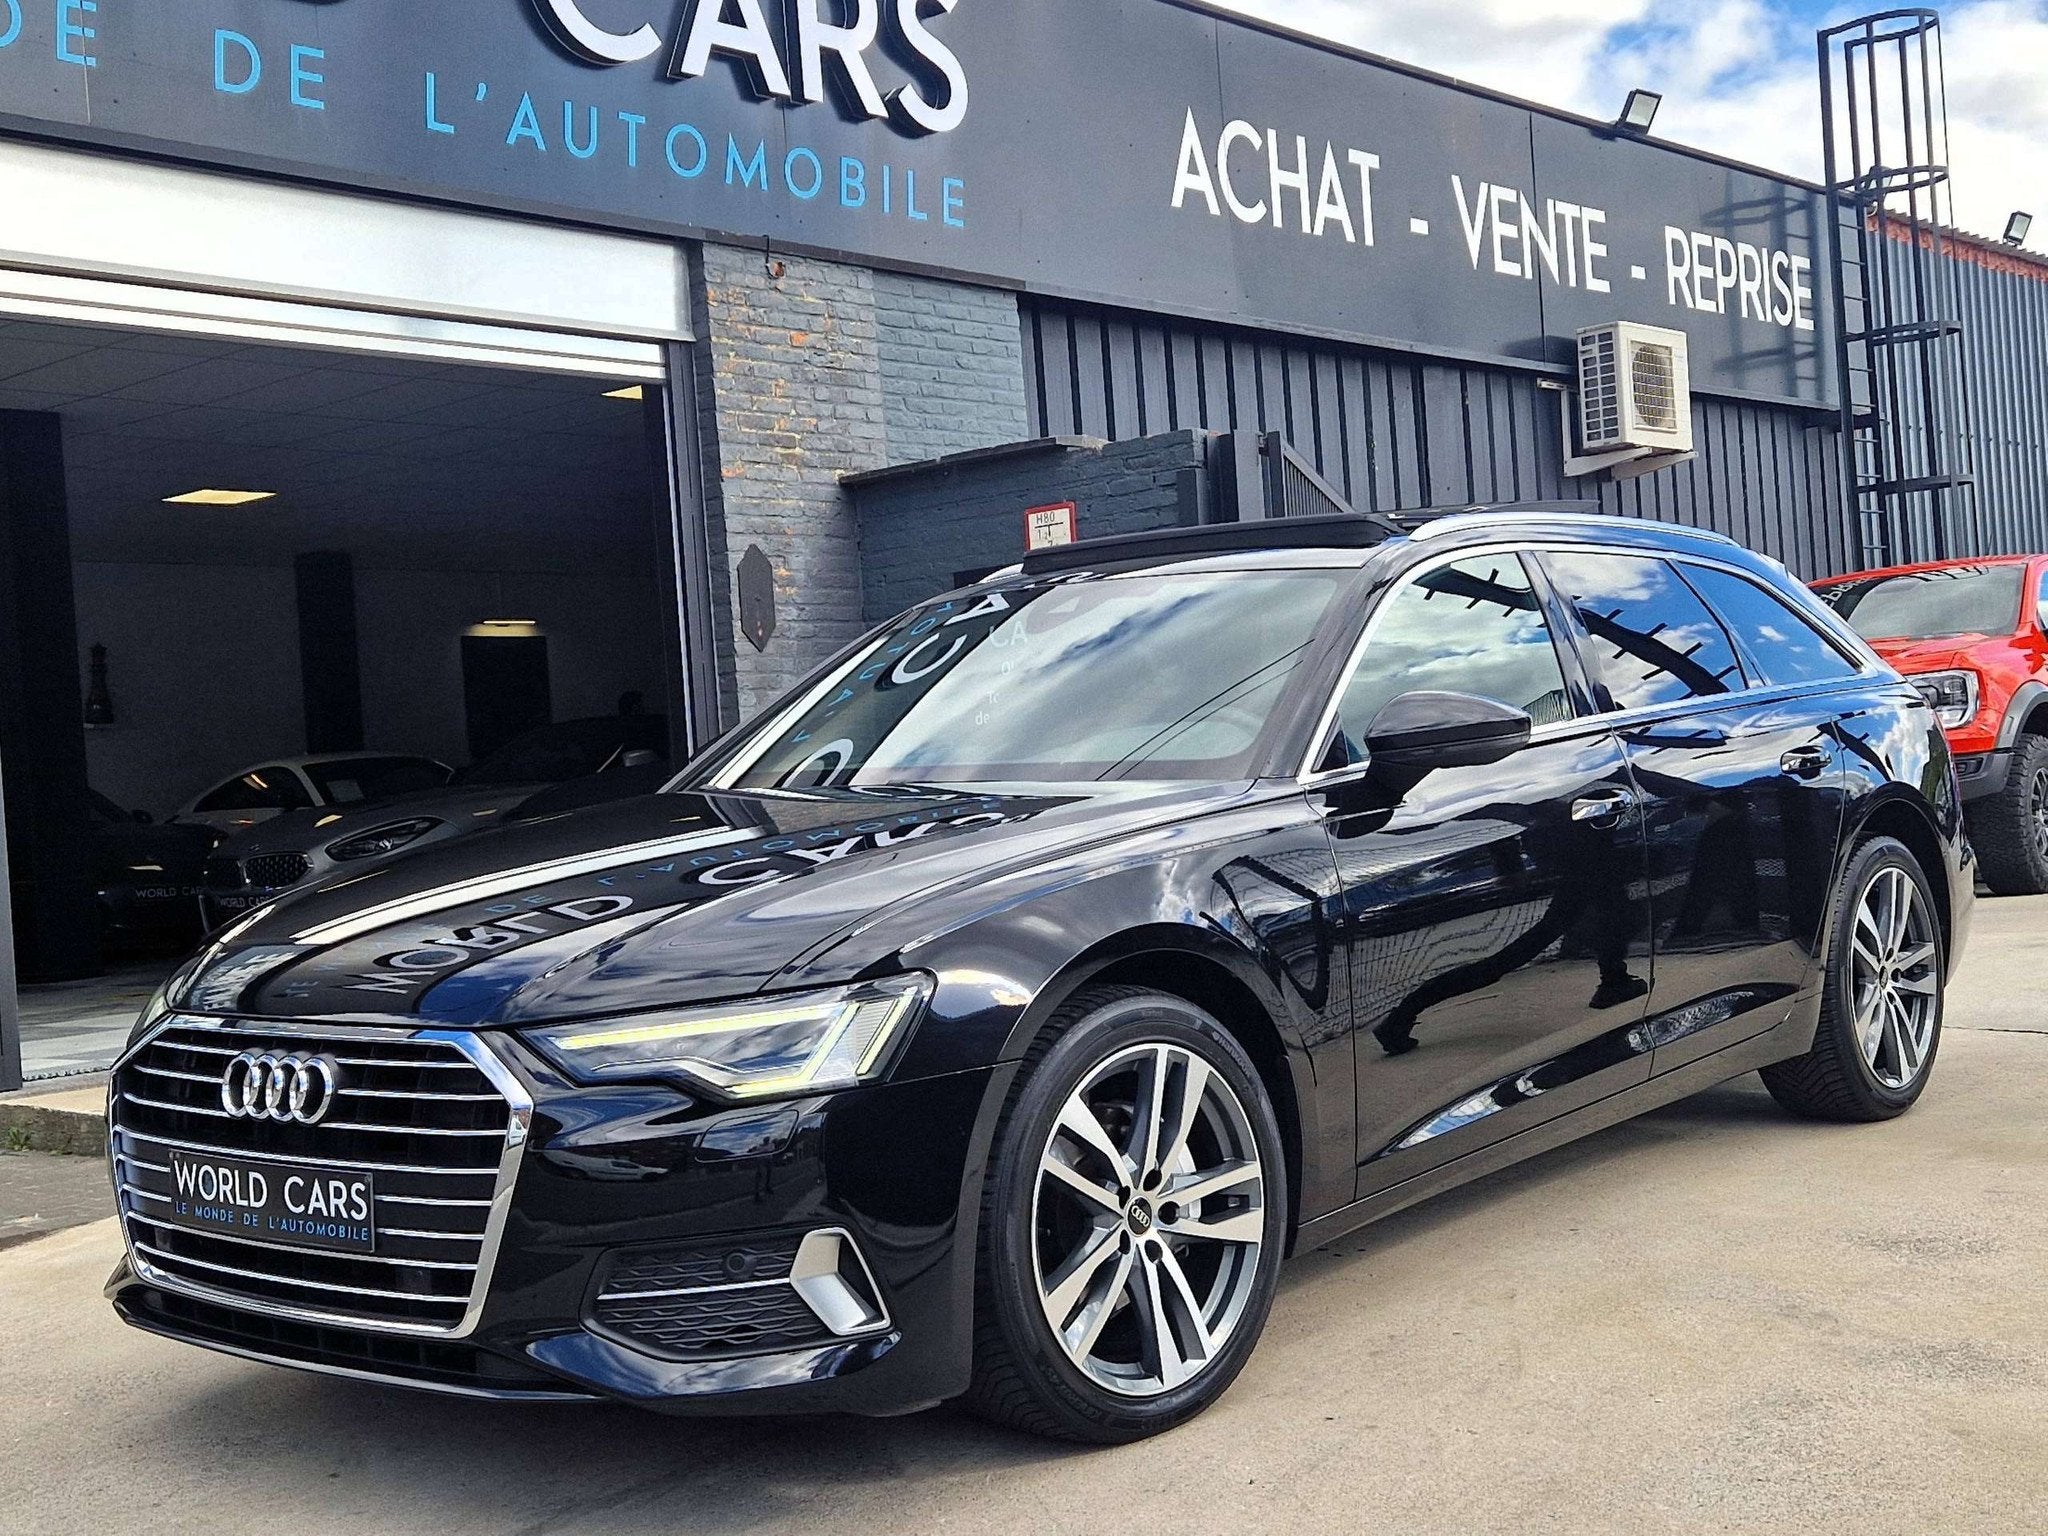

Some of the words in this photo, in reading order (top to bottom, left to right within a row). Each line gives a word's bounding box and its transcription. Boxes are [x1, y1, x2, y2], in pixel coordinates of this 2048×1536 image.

[214, 28, 325, 110] DE
[425, 72, 966, 228] L'AUTOMOBILE
[1171, 105, 1380, 247] ACHAT
[1451, 174, 1611, 293] VENTE
[1665, 225, 1815, 331] REPRISE
[135, 887, 178, 899] WORLD
[174, 1160, 268, 1208] WORLD
[284, 1175, 368, 1221] CARS
[175, 1201, 187, 1215] LE
[194, 1205, 234, 1223] MONDE
[243, 1214, 259, 1227] DE
[268, 1215, 369, 1241] L'AUTOMOBILE
